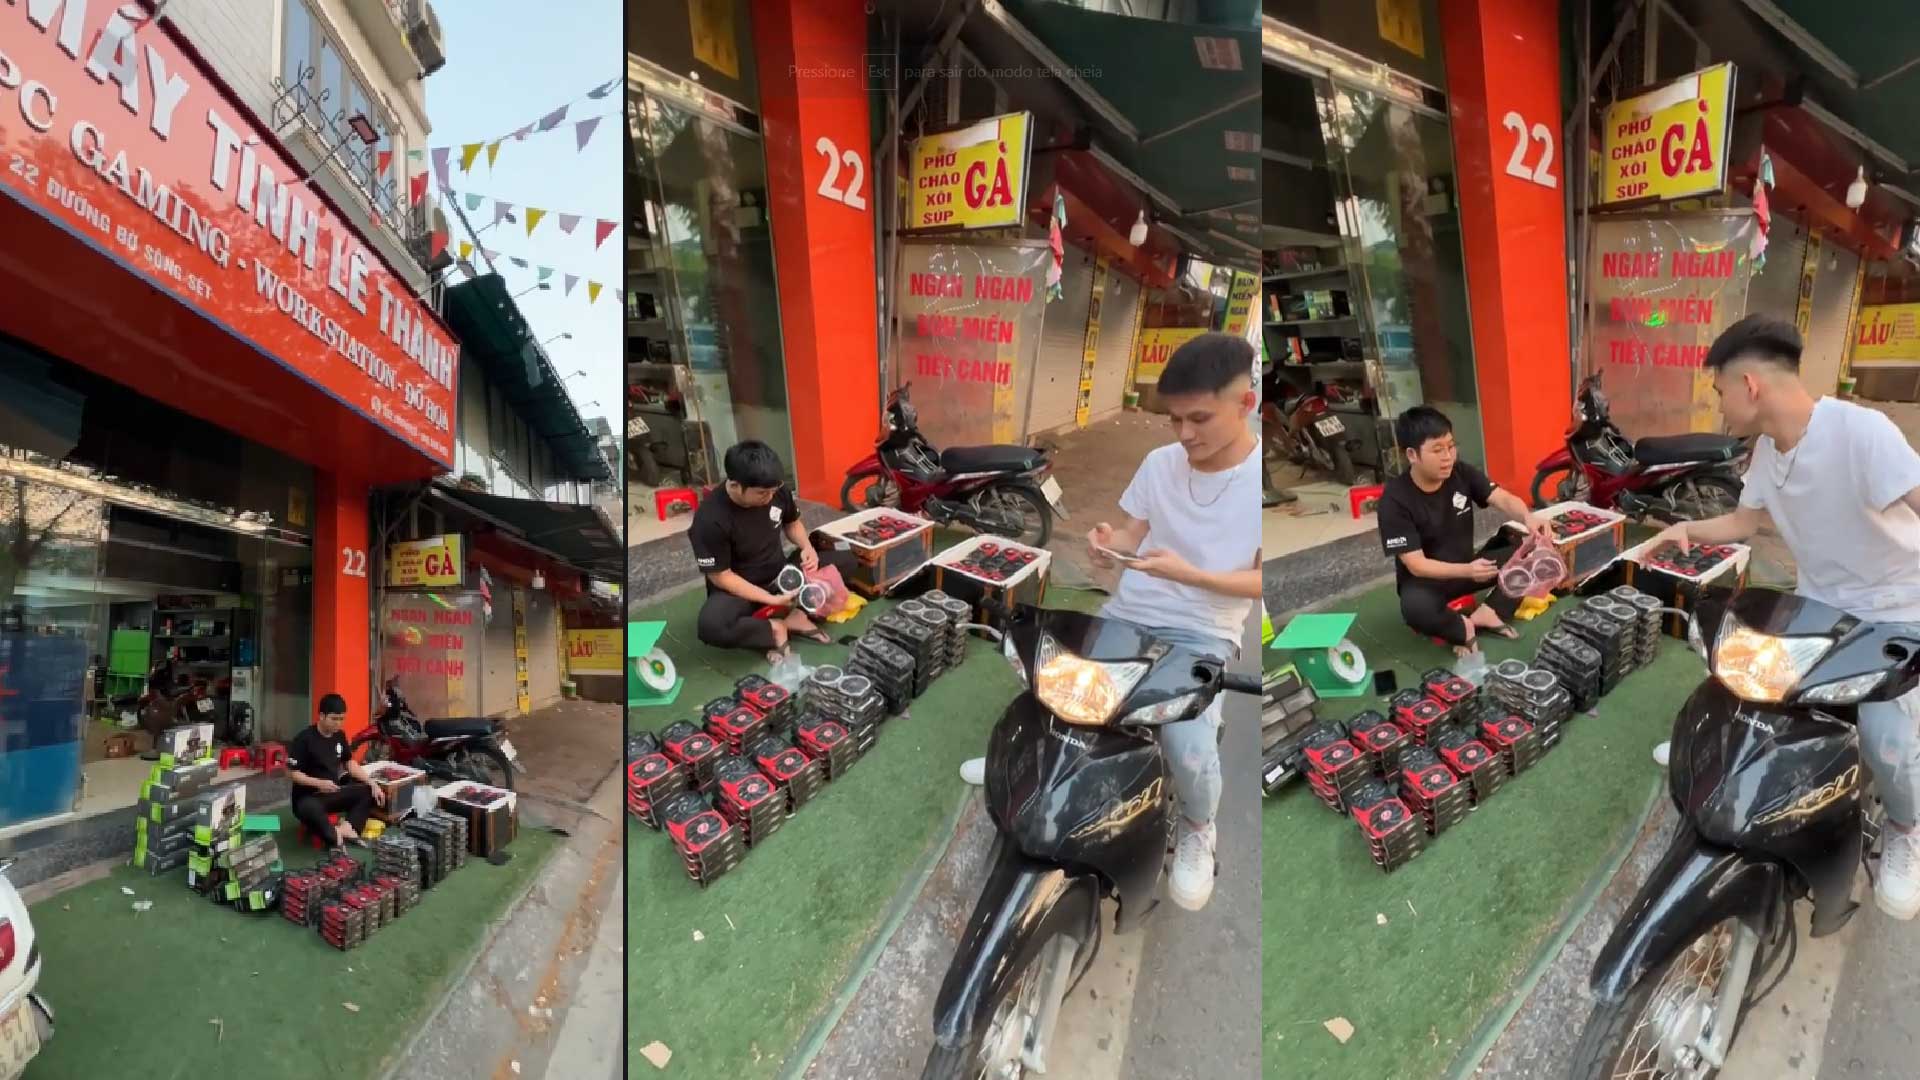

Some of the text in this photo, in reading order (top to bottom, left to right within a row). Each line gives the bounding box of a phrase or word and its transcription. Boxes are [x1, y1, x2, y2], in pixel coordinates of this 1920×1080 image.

[1502, 112, 1558, 189] 22
[1661, 99, 1712, 177] GÀ
[9, 153, 40, 186] 22
[816, 136, 867, 211] 22
[964, 141, 1013, 209] GÀ
[69, 119, 231, 269] GAMING
[253, 255, 398, 391] WORKSTATION
[207, 107, 319, 270] TÍNH
[328, 236, 369, 317] LÊ
[376, 276, 453, 393] THÀNH
[1603, 250, 1736, 278] NGAN NGAN
[909, 272, 1034, 304] NGAN NGAN
[957, 358, 1012, 385] CANH
[342, 546, 366, 578] 22
[425, 546, 456, 576] GÀ
